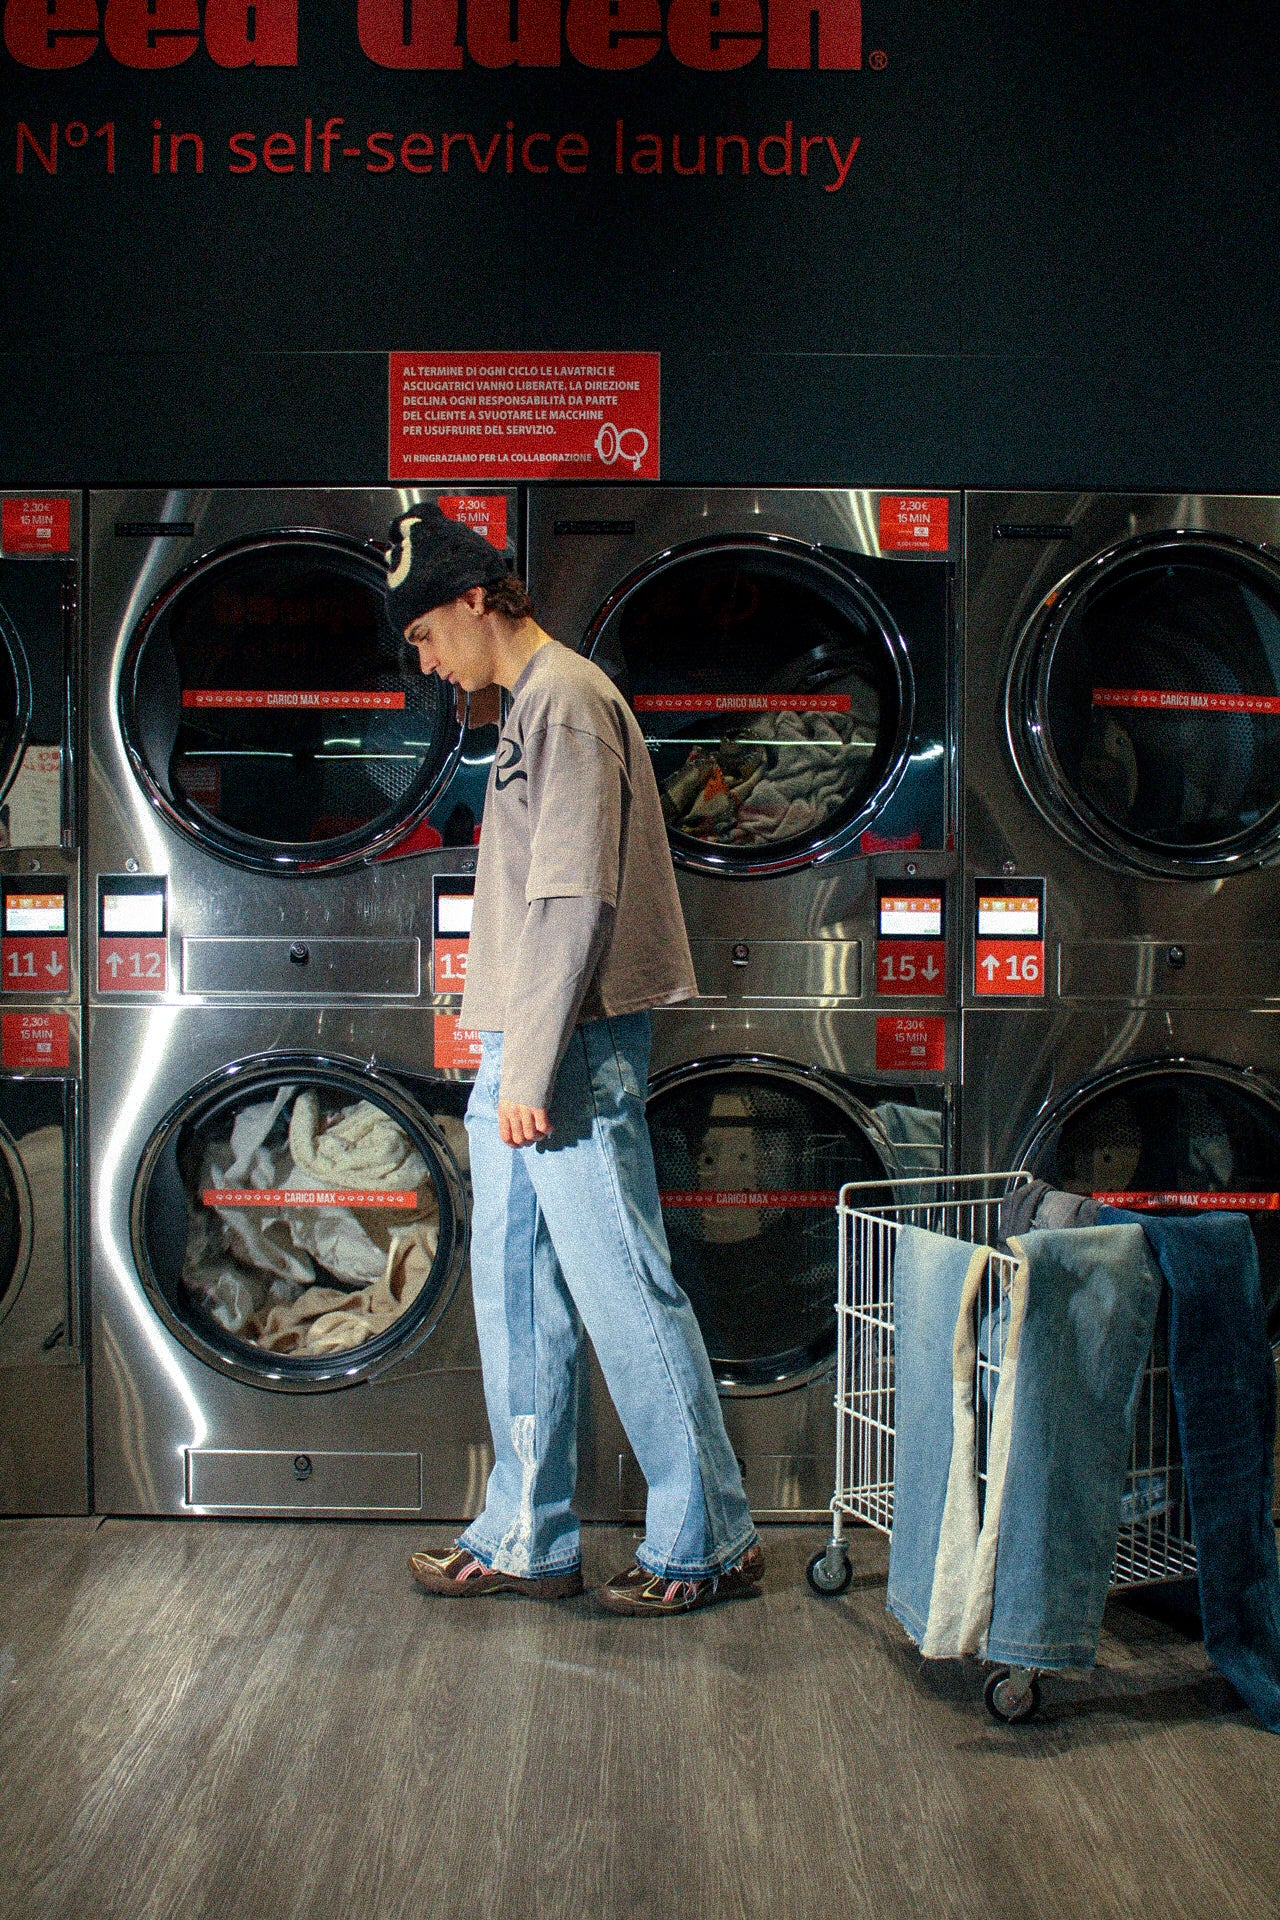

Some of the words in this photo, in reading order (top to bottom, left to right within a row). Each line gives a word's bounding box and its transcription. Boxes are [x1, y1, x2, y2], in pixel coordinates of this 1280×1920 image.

[151, 118, 204, 174] in
[228, 117, 590, 174] self-service
[615, 119, 861, 192] laundry
[403, 366, 416, 376] AL
[418, 366, 463, 376] TERMINE
[466, 366, 476, 376] DI
[479, 366, 505, 376] OGNI
[508, 366, 538, 376] CICLO
[540, 366, 552, 376] LE
[554, 366, 606, 376] LAVATRICI
[609, 366, 614, 376] E
[403, 381, 474, 391] ASCIUGATRICI
[476, 381, 514, 391] VANNO
[516, 381, 567, 391] LIBERATE.
[569, 381, 582, 391] LA
[585, 381, 640, 391] DIREZIONE
[403, 396, 447, 405] DECLINA
[450, 396, 476, 405] OGNI
[479, 394, 566, 405] RESPONSABILITÀ
[568, 396, 583, 405] DA
[586, 396, 618, 405] PARTE
[403, 410, 422, 420] DEL
[424, 410, 466, 420] CLIENTE
[468, 410, 476, 420] A
[478, 410, 533, 420] SVUOTARE
[535, 410, 547, 420] LE
[550, 410, 603, 420] MACCHINE
[403, 425, 422, 435] PER
[424, 425, 482, 435] USUFRUIRE
[484, 425, 504, 435] DEL
[506, 425, 557, 435] SERVIZIO.
[402, 454, 412, 462] VI
[414, 454, 477, 462] RINGRAZIAMO
[479, 454, 496, 462] PER
[498, 454, 508, 462] LA
[511, 454, 591, 462] COLLABORAZIONE
[21, 515, 31, 525] 15
[32, 515, 53, 525] MIN
[456, 513, 466, 522] 15
[468, 513, 490, 522] MIN
[909, 513, 931, 523] MIN
[267, 694, 298, 705] CARICO
[300, 694, 320, 705] MAX
[716, 697, 746, 708] CARICO
[749, 698, 768, 708] MAX
[1160, 694, 1188, 706] CARICO
[1190, 696, 1209, 707] MAX
[7, 952, 38, 977] 11
[129, 951, 162, 978] 12
[882, 955, 916, 981] 15
[1005, 954, 1039, 981] 16
[21, 1030, 31, 1039] 15
[32, 1030, 53, 1039] MIN
[453, 1031, 462, 1041] 15
[895, 1033, 905, 1042] 15
[906, 1033, 927, 1042] MIN
[284, 1192, 314, 1203] CARICO
[316, 1193, 336, 1203] MAX
[716, 1193, 747, 1204] CARICO
[749, 1194, 768, 1204] MAX
